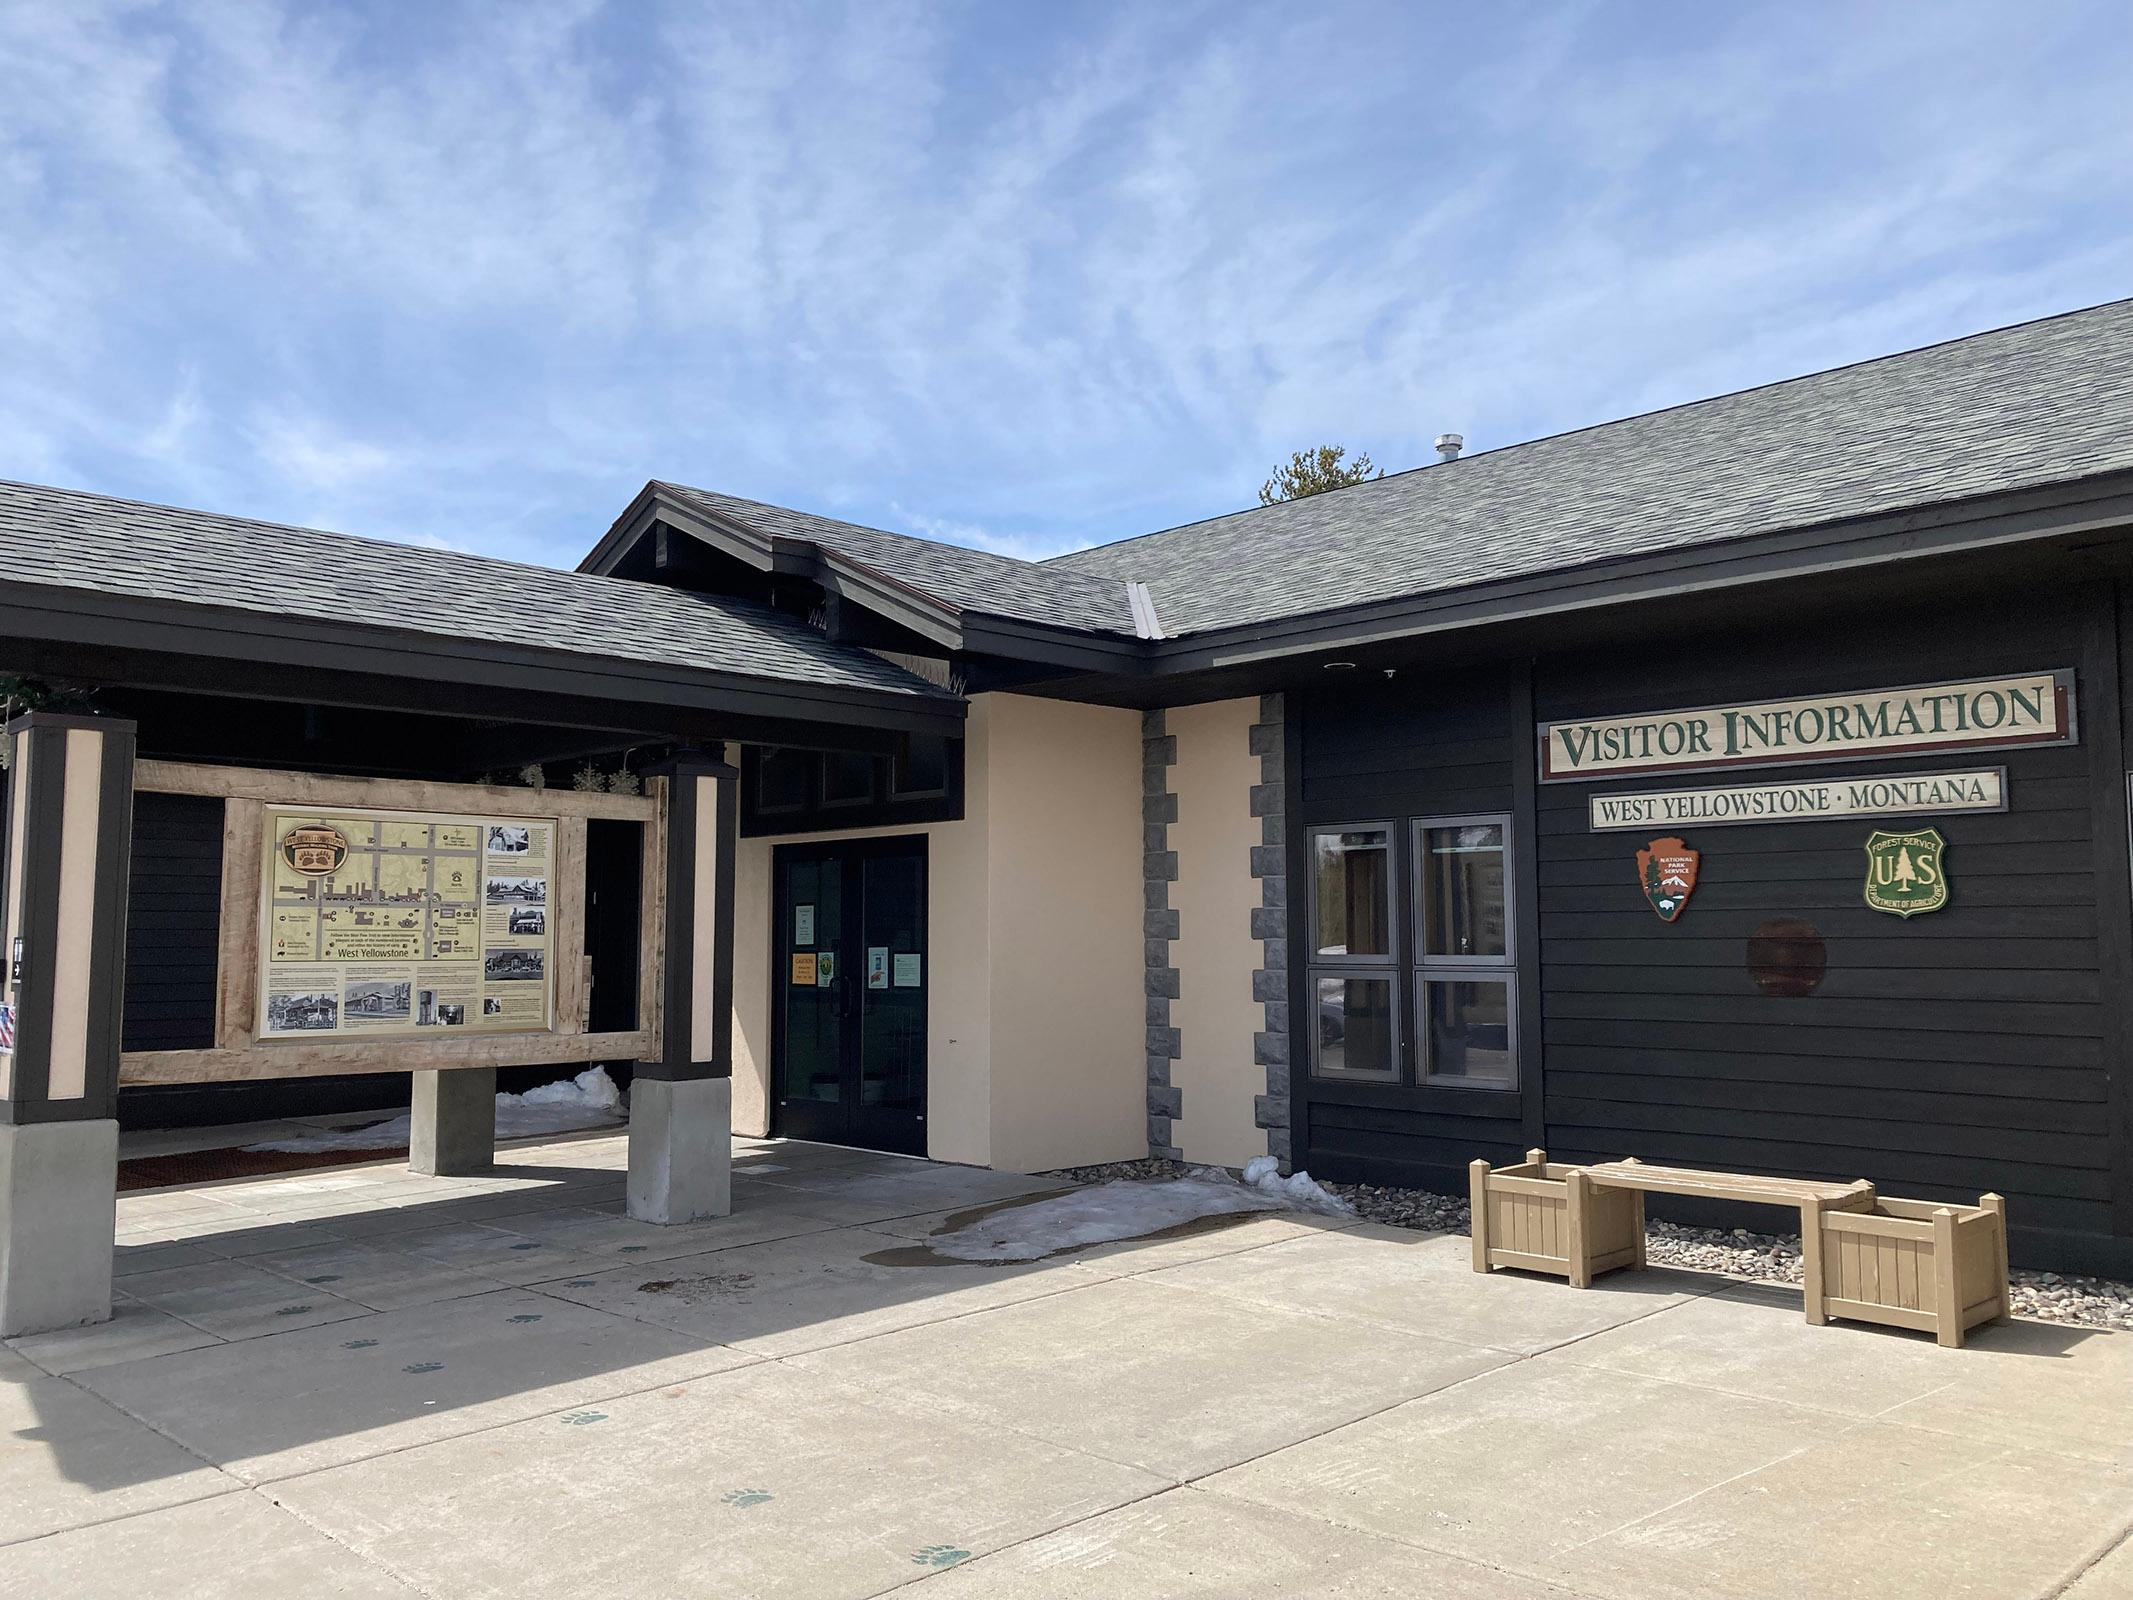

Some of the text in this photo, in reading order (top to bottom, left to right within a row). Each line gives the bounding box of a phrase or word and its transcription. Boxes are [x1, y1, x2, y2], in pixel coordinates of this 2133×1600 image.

[1557, 686, 2044, 767] VISITOR INFORMATION
[1600, 777, 1987, 822] WEST YELLOWSTONE MONTANA
[1872, 837, 1936, 853] FOREST SERVICE
[1869, 884, 1943, 908] DEPARTMENT OF AGRICULTURE
[338, 949, 409, 957] West Yellowstone
